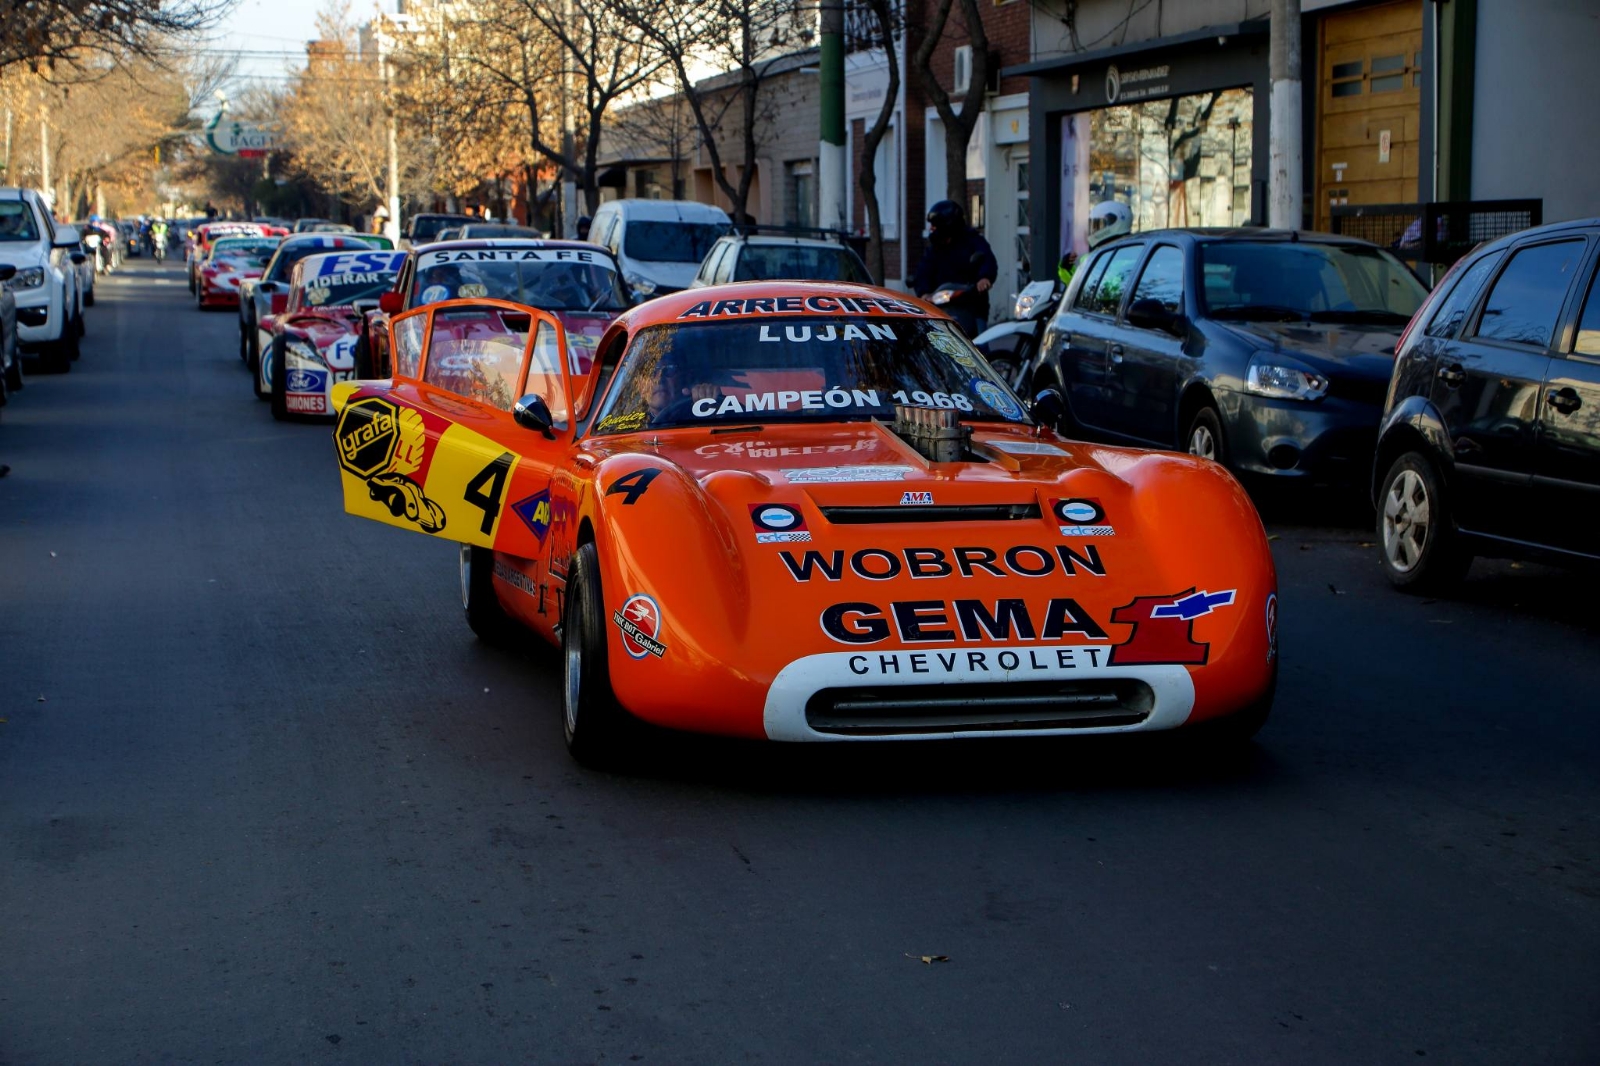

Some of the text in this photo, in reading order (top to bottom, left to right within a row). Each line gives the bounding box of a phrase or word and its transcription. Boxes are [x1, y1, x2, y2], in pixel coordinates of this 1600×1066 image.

[434, 251, 593, 264] SANTA FE
[304, 272, 380, 293] LIDERAR
[676, 296, 928, 319] ARRECIFES
[759, 323, 898, 342] LUJAN
[290, 371, 311, 388] Ford
[691, 385, 974, 418] CAMPEÓN 1968
[342, 411, 392, 461] grafa
[463, 451, 517, 537] 4
[605, 467, 663, 505] 4
[901, 492, 932, 502] AMA
[757, 532, 790, 543] cdc
[1061, 525, 1092, 536] cdc
[777, 544, 1107, 584] WOBRON
[820, 598, 1110, 645] GEMA
[1107, 587, 1211, 667] 1
[634, 632, 665, 656] Gabriel
[848, 647, 1101, 675] CHEVROLET
